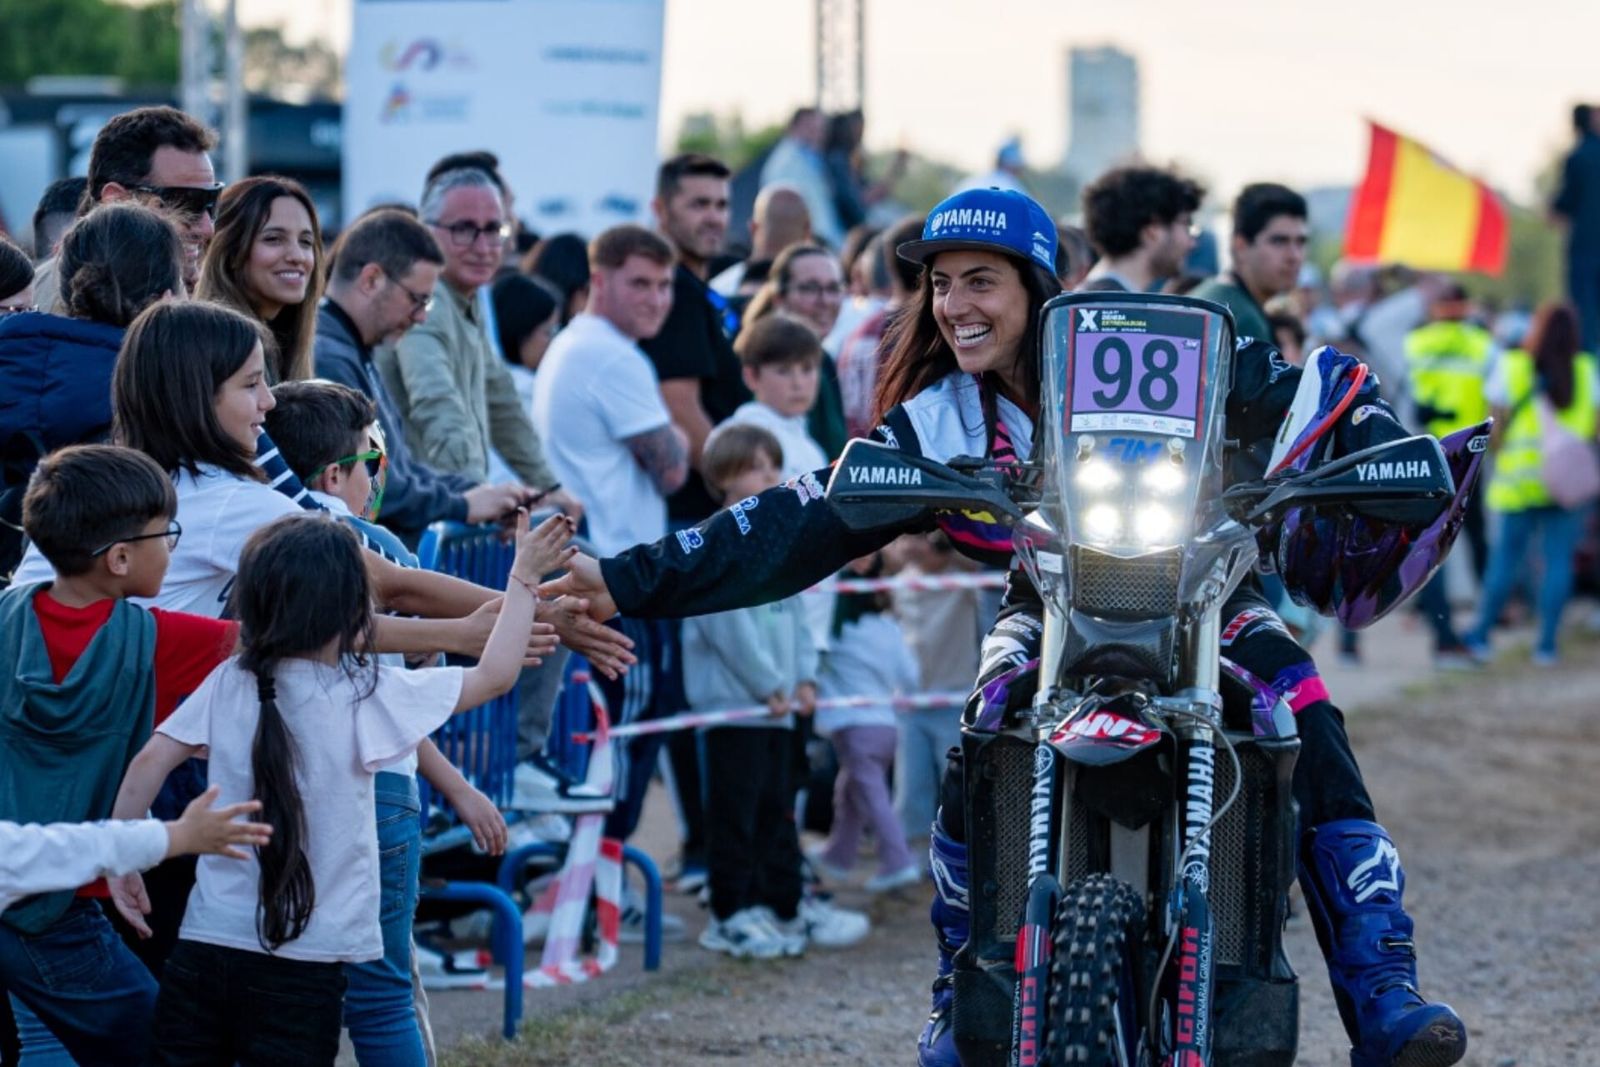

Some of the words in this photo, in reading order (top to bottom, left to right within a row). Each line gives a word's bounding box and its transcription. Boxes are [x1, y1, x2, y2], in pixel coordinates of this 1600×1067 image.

[943, 209, 1007, 230] YAMAHA
[1092, 336, 1179, 412] 98
[849, 466, 922, 485] YAMAHA
[1356, 460, 1431, 481] YAMAHA
[1185, 746, 1215, 858] YAMAHA
[1027, 776, 1051, 888] YAMAH
